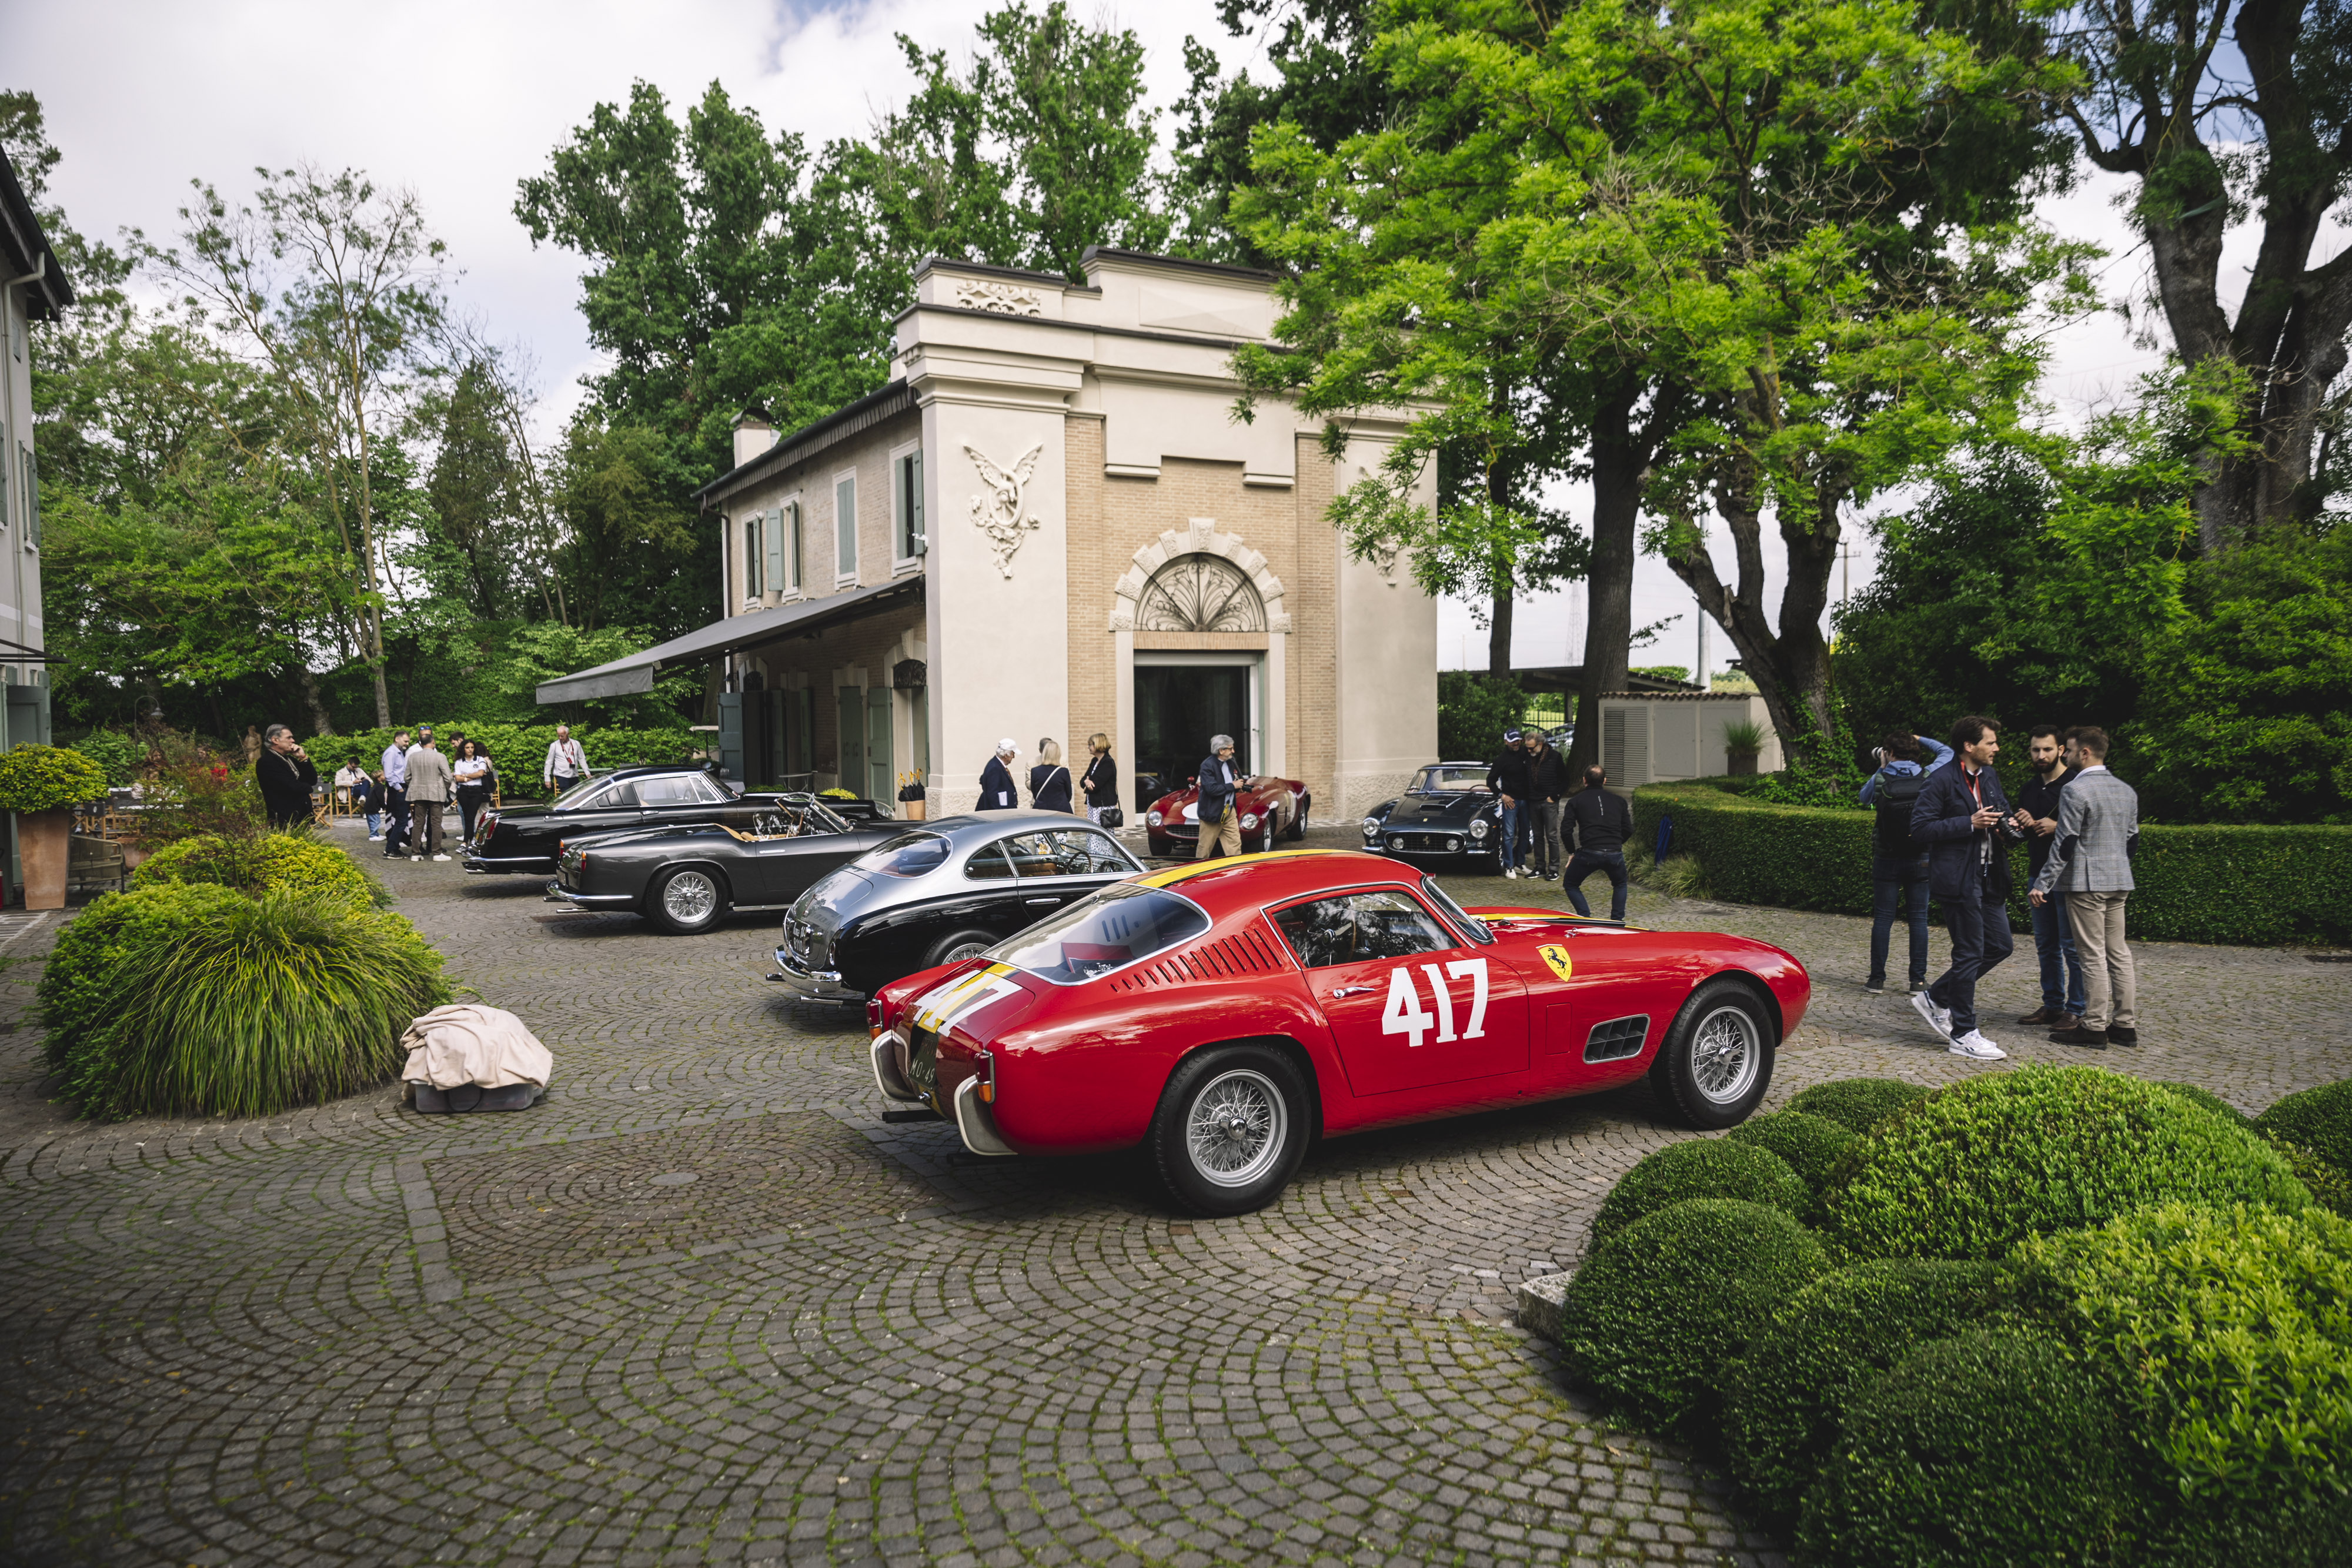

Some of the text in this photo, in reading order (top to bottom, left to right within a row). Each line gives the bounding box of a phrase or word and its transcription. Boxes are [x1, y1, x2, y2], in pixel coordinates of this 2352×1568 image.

[794, 937, 803, 952] 8110
[913, 969, 1023, 1038] 417
[1382, 958, 1489, 1047] 417
